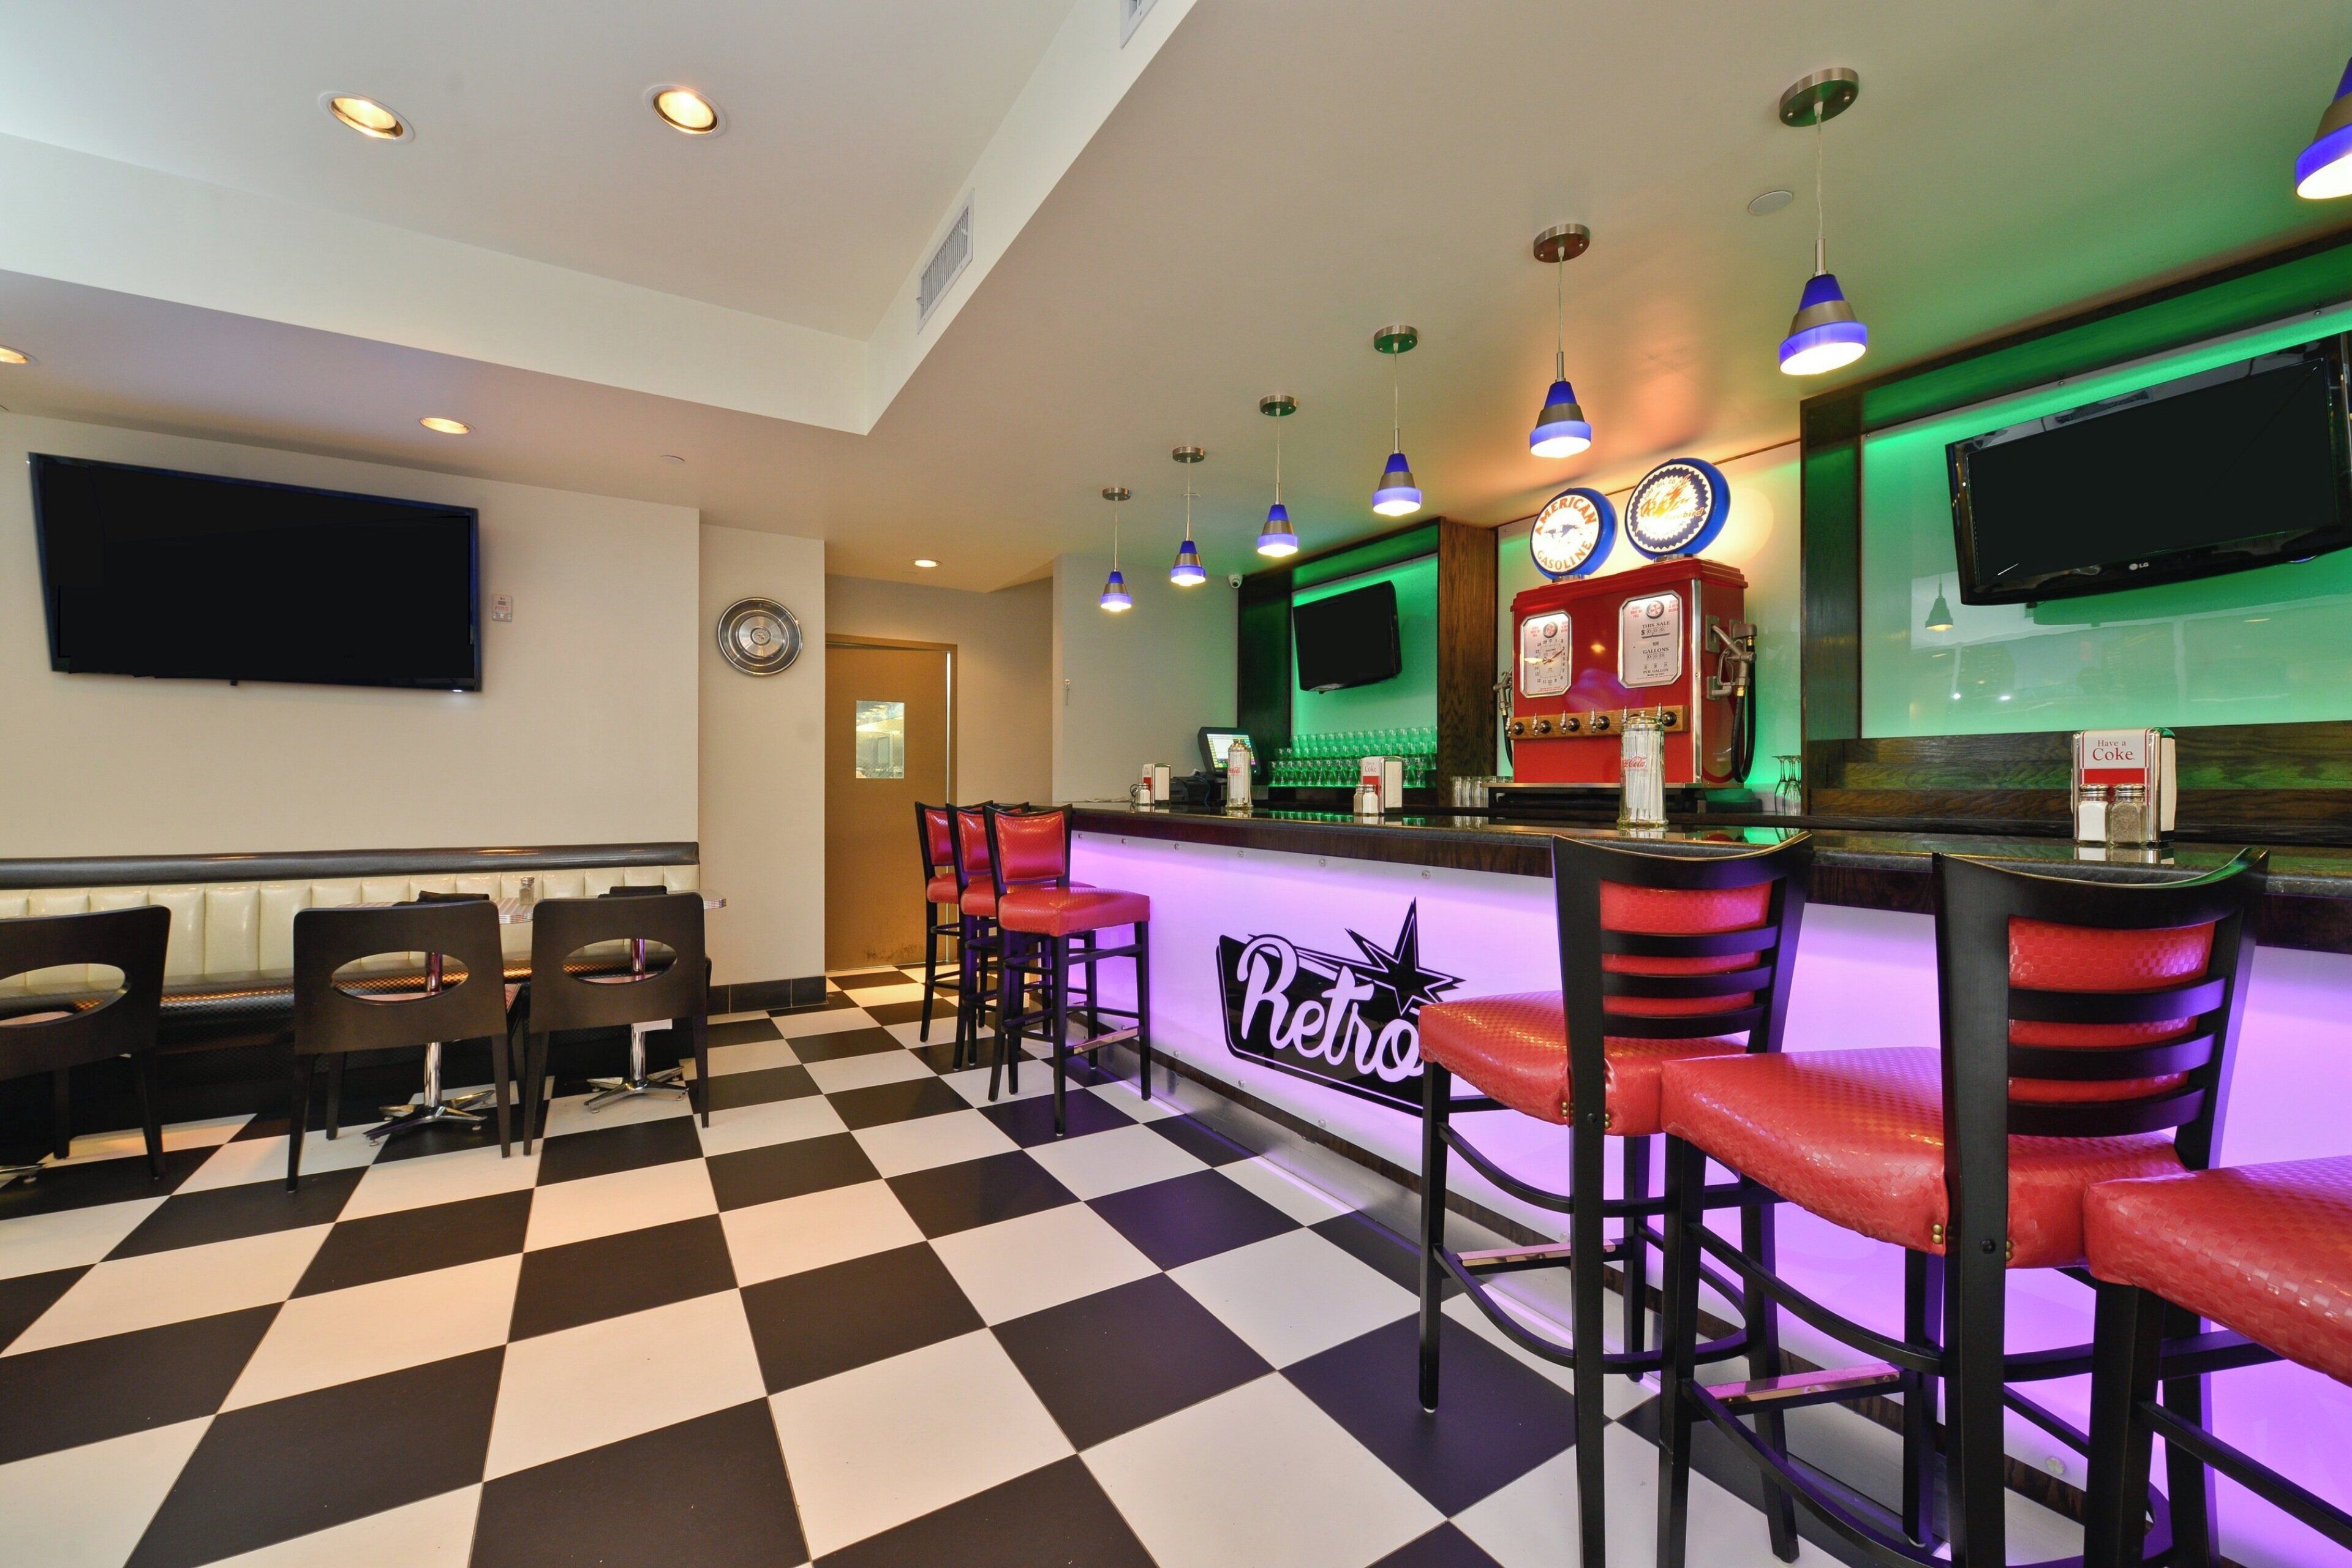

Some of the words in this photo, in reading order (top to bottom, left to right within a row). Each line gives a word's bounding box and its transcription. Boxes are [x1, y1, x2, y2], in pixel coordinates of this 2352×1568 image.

[1536, 497, 1597, 535] AMERICAN
[1537, 541, 1592, 570] GASOLINE
[2092, 747, 2133, 761] Coke
[1237, 937, 1424, 1082] Retro
